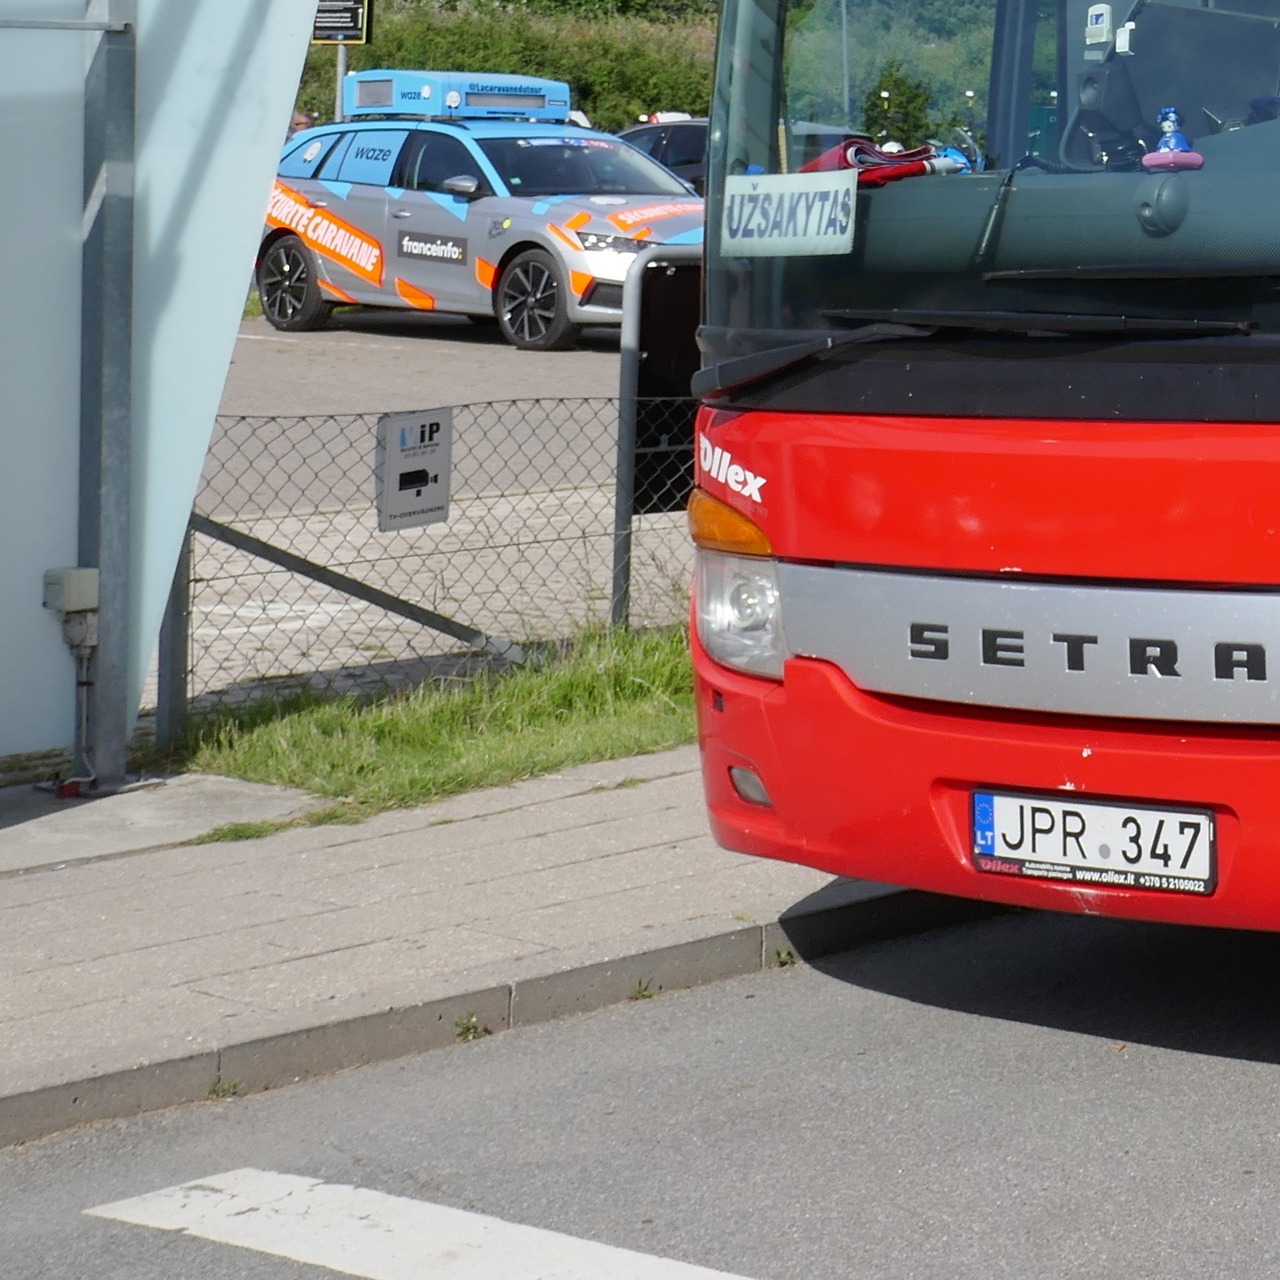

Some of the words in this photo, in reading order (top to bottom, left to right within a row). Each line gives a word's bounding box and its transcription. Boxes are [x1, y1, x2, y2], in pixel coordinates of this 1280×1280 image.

[400, 91, 422, 100] waze
[355, 146, 392, 161] waze
[727, 182, 852, 239] UŽSAKYTAS
[307, 216, 380, 272] CARAVANE
[909, 622, 1268, 682] SETRA
[976, 830, 994, 846] LT
[1001, 804, 1088, 859] JPR
[1121, 816, 1201, 870] 347
[1075, 870, 1135, 885] www.ollex.lt
[1139, 875, 1160, 887] +370
[1162, 878, 1168, 888] 5
[1169, 878, 1205, 892] 2105022
